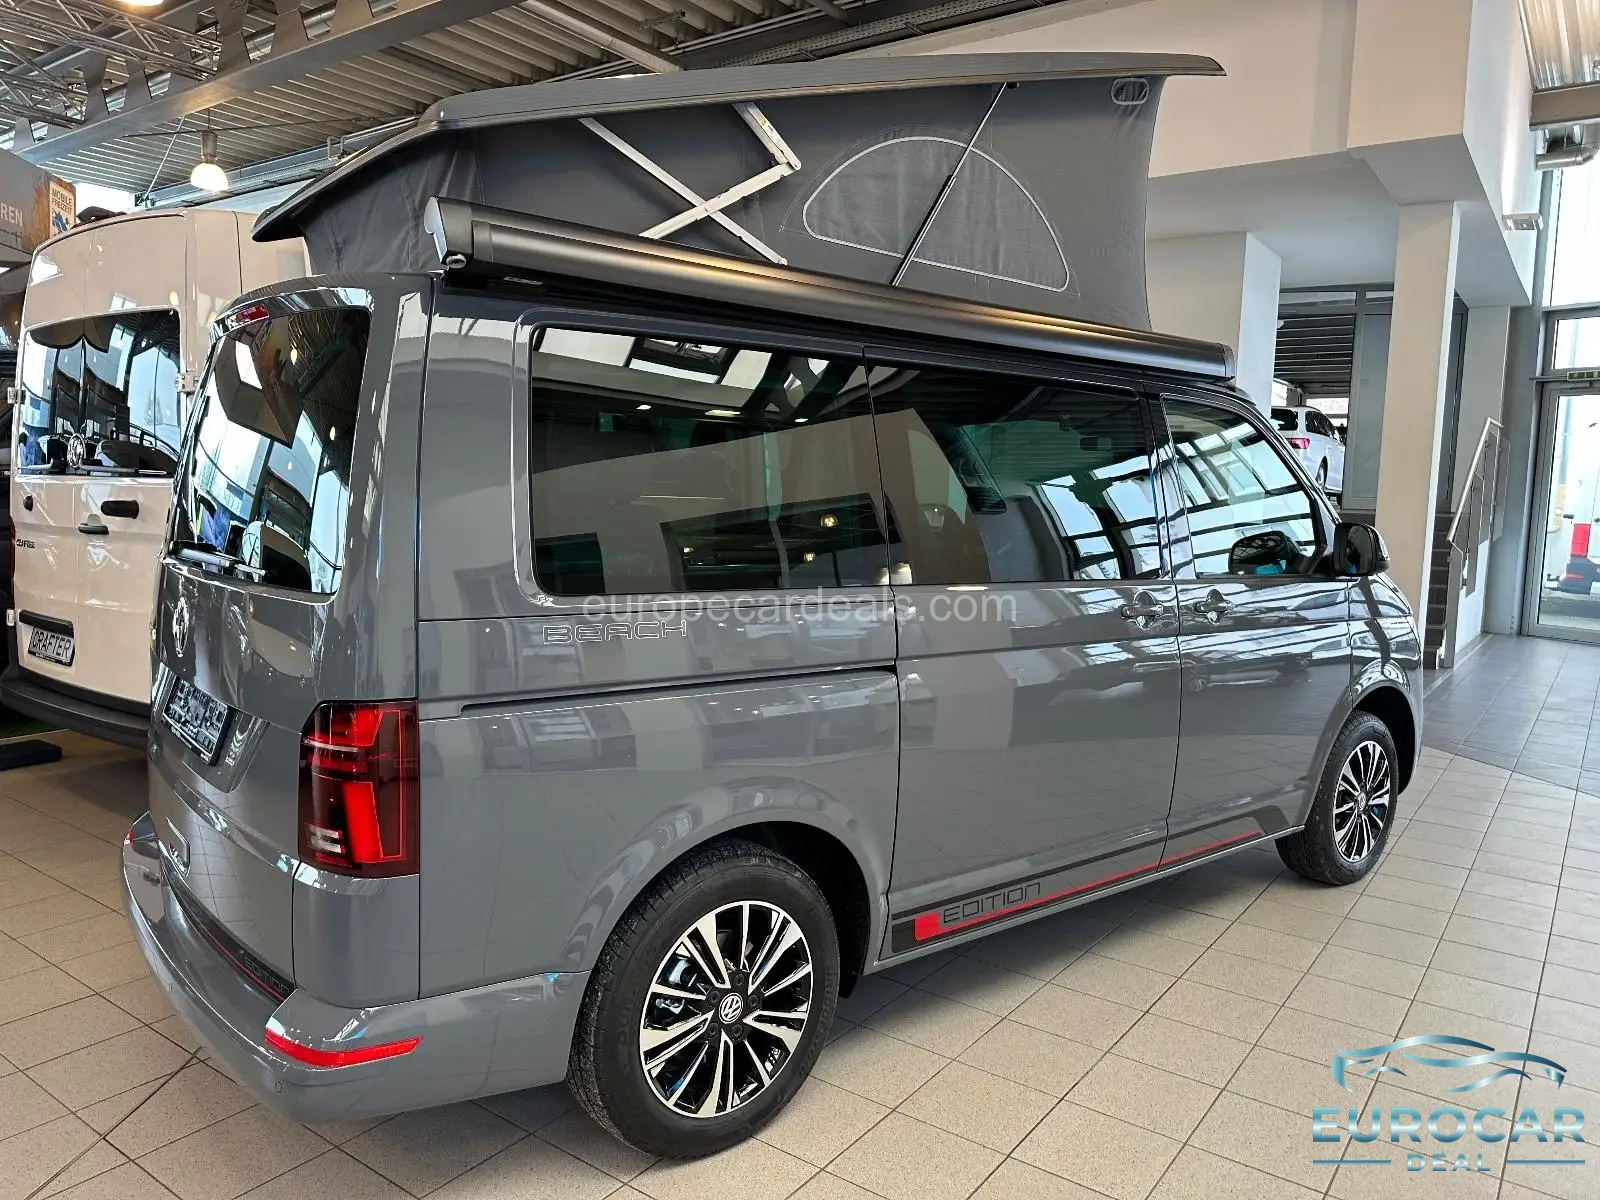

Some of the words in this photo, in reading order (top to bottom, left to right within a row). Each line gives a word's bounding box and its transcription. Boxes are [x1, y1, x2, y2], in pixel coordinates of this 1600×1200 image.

[52, 188, 72, 206] MOBILE
[542, 620, 688, 644] BEACH
[943, 882, 1041, 924] EDITION
